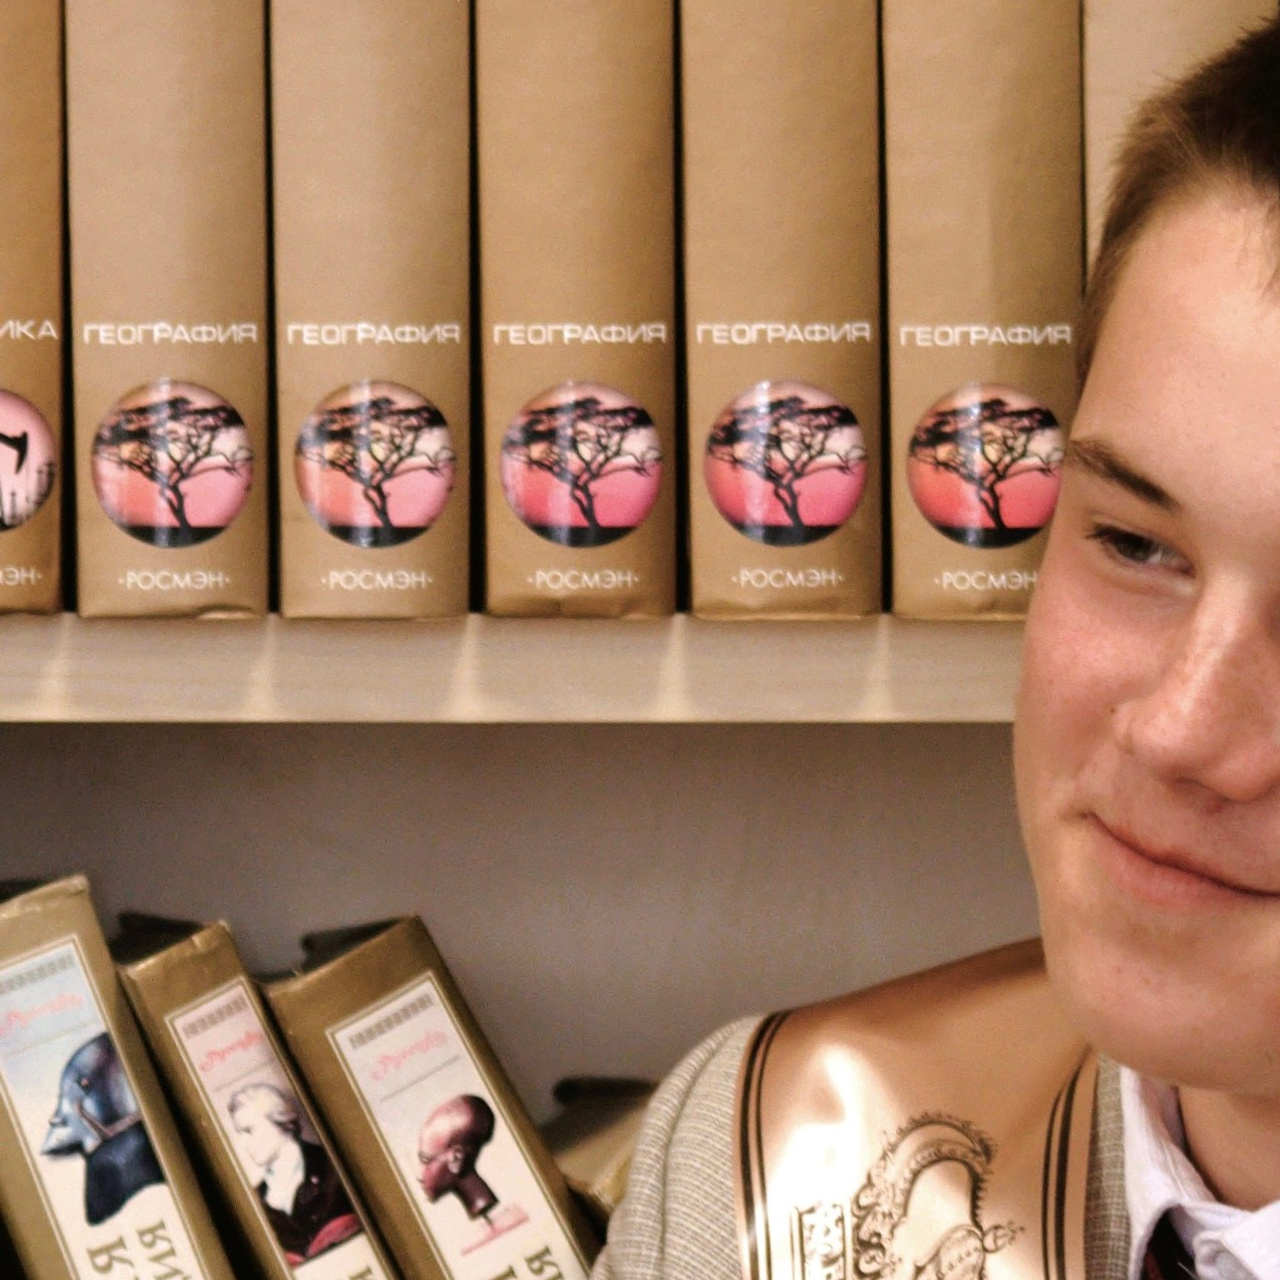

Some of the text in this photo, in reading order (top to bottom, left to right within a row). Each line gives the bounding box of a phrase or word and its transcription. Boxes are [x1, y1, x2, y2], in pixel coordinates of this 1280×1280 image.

[82, 320, 258, 345] ГЕОГРАФИЯ
[286, 321, 461, 345] ГЕОГРАФИЯ
[493, 321, 667, 345] ГЕОГРАФИЯ
[696, 320, 872, 345] ГЕОГРАФИЯ
[899, 322, 1073, 347] ГЕОГРАФИЯ
